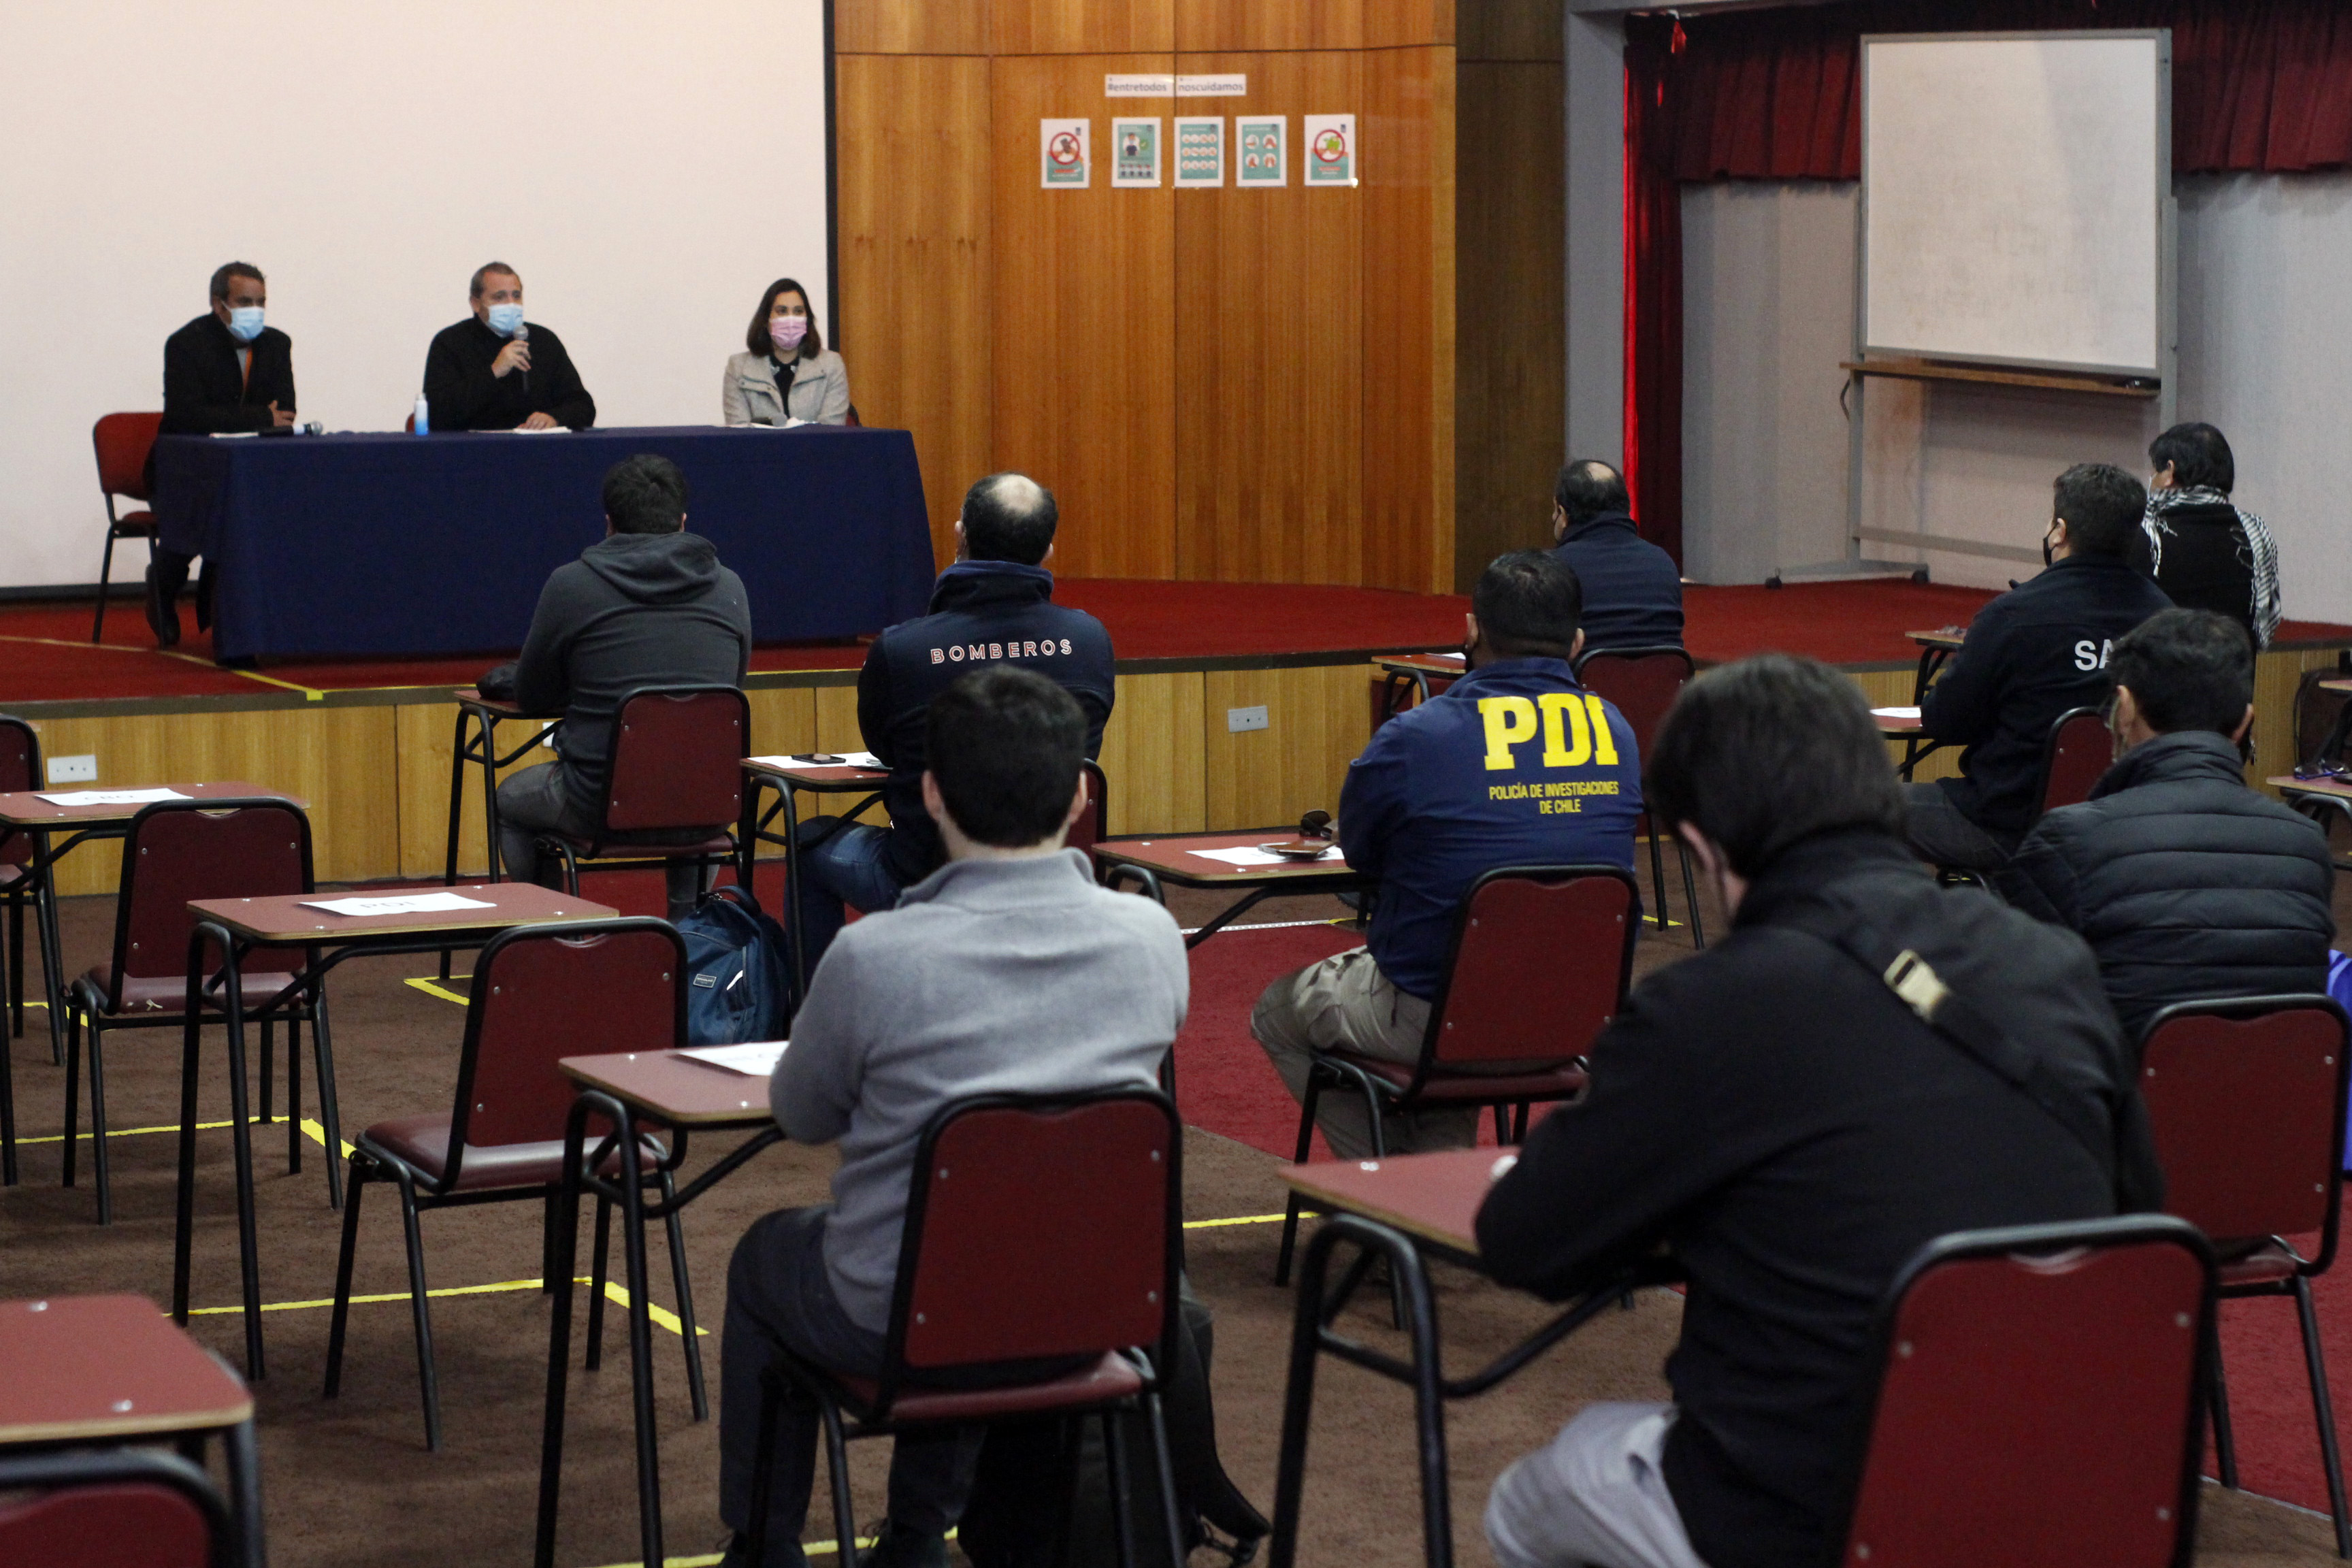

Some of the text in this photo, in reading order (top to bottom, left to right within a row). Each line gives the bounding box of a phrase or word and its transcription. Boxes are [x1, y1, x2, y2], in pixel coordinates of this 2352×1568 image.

[1108, 82, 1243, 92] #entretodos noscuidamos
[930, 638, 1073, 664] BOMBEROS
[1477, 693, 1619, 770] PDI
[1489, 781, 1619, 800] POLICÍA DE INVESTIGACIONES
[1539, 799, 1582, 815] DE CHILE
